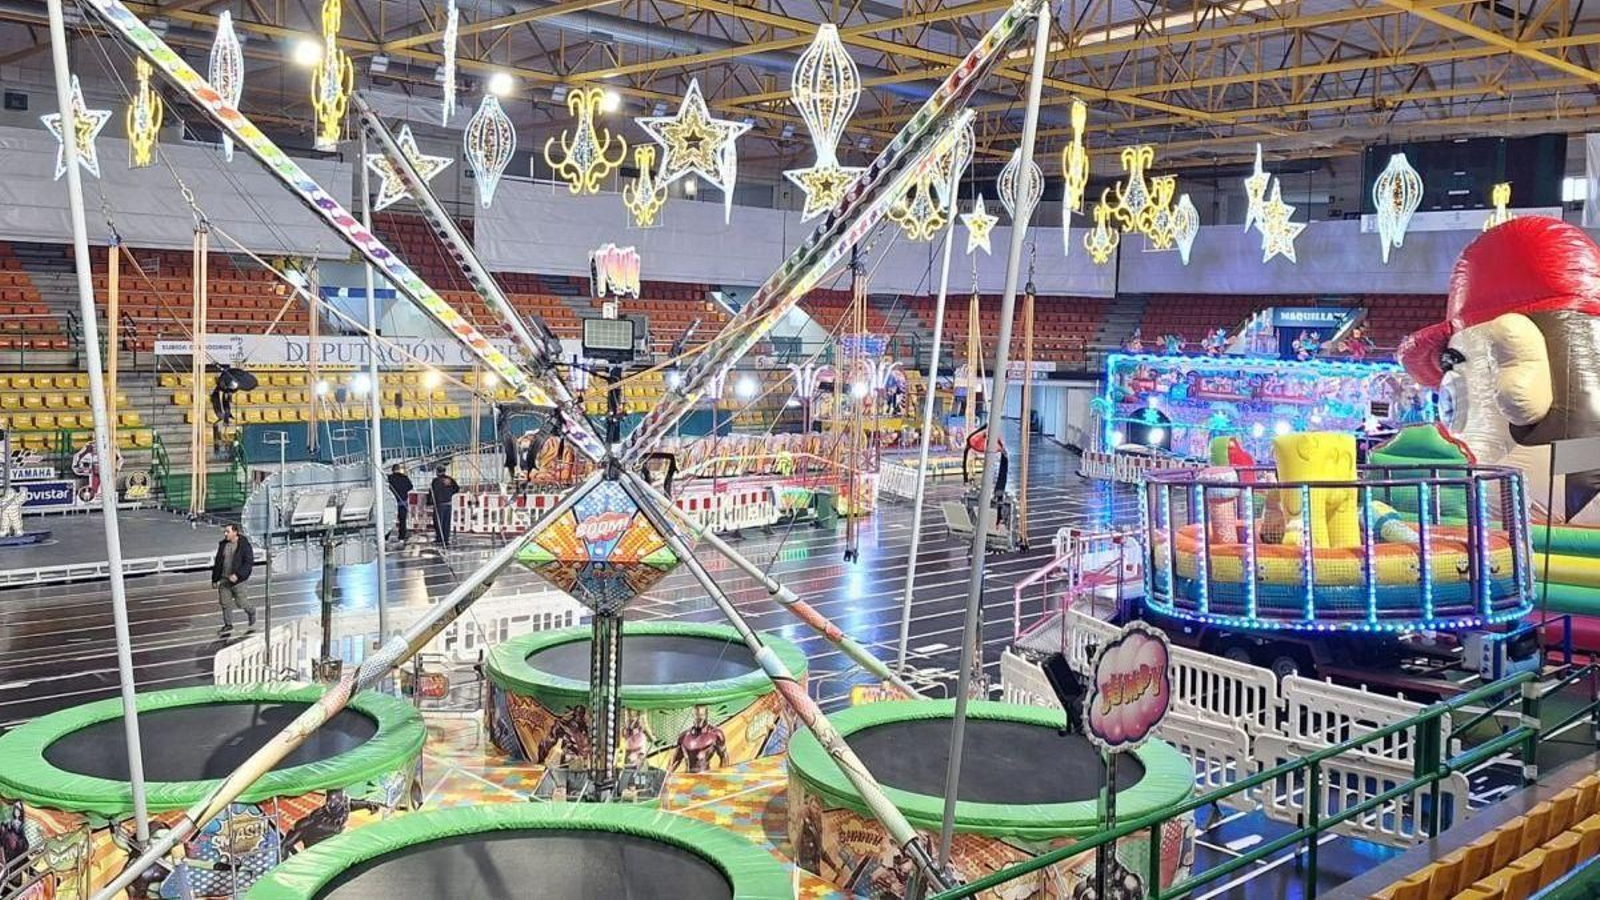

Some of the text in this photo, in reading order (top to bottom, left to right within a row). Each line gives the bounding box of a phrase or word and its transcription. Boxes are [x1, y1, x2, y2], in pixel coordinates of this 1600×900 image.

[12, 468, 52, 478] YAMAHA
[26, 489, 69, 501] ovistar
[576, 517, 630, 537] BOOM!
[1101, 663, 1163, 716] JUMPY
